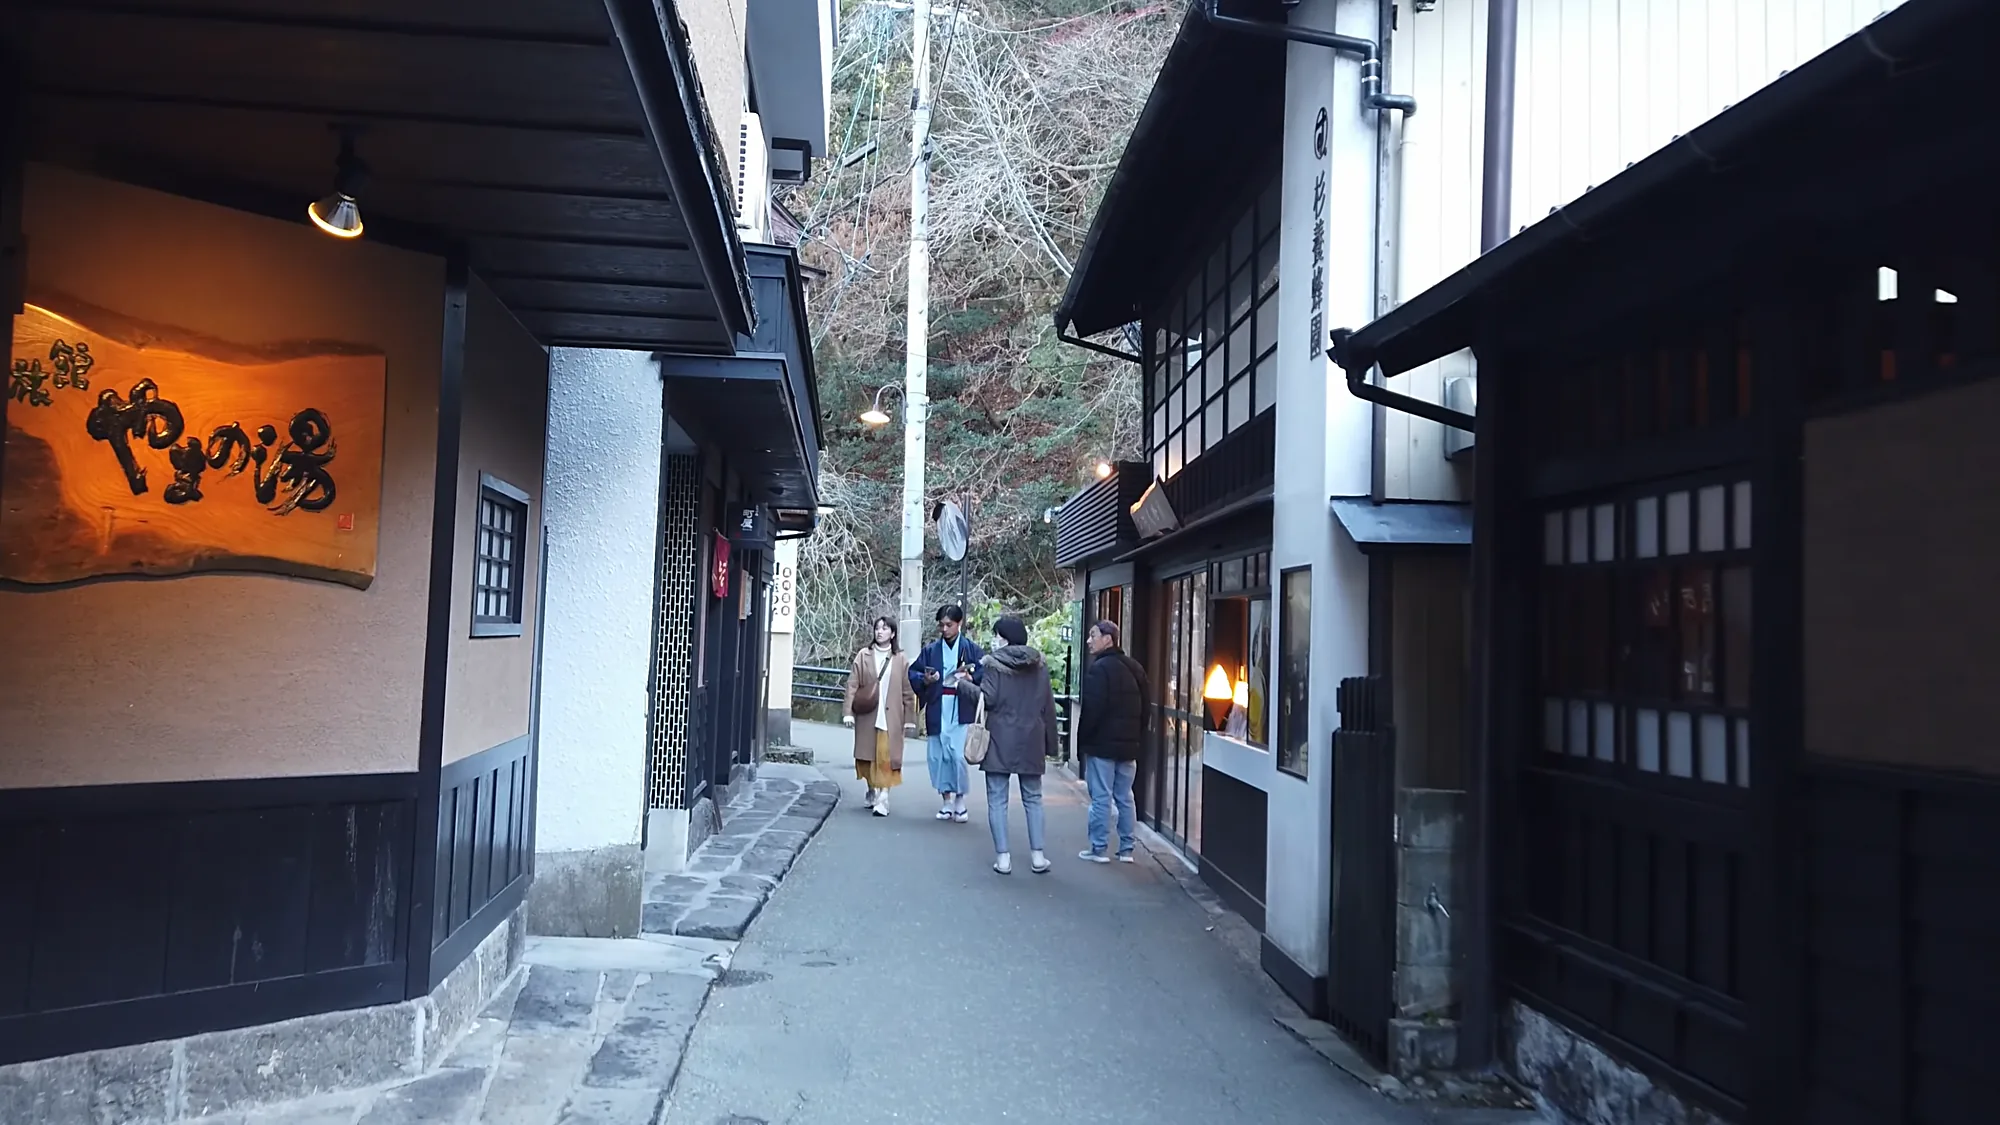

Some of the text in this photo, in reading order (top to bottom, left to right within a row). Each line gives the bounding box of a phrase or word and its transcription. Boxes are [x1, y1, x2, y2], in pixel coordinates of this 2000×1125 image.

[1310, 170, 1325, 361] 杉養蜂園
[87, 377, 337, 516] やまの湯
